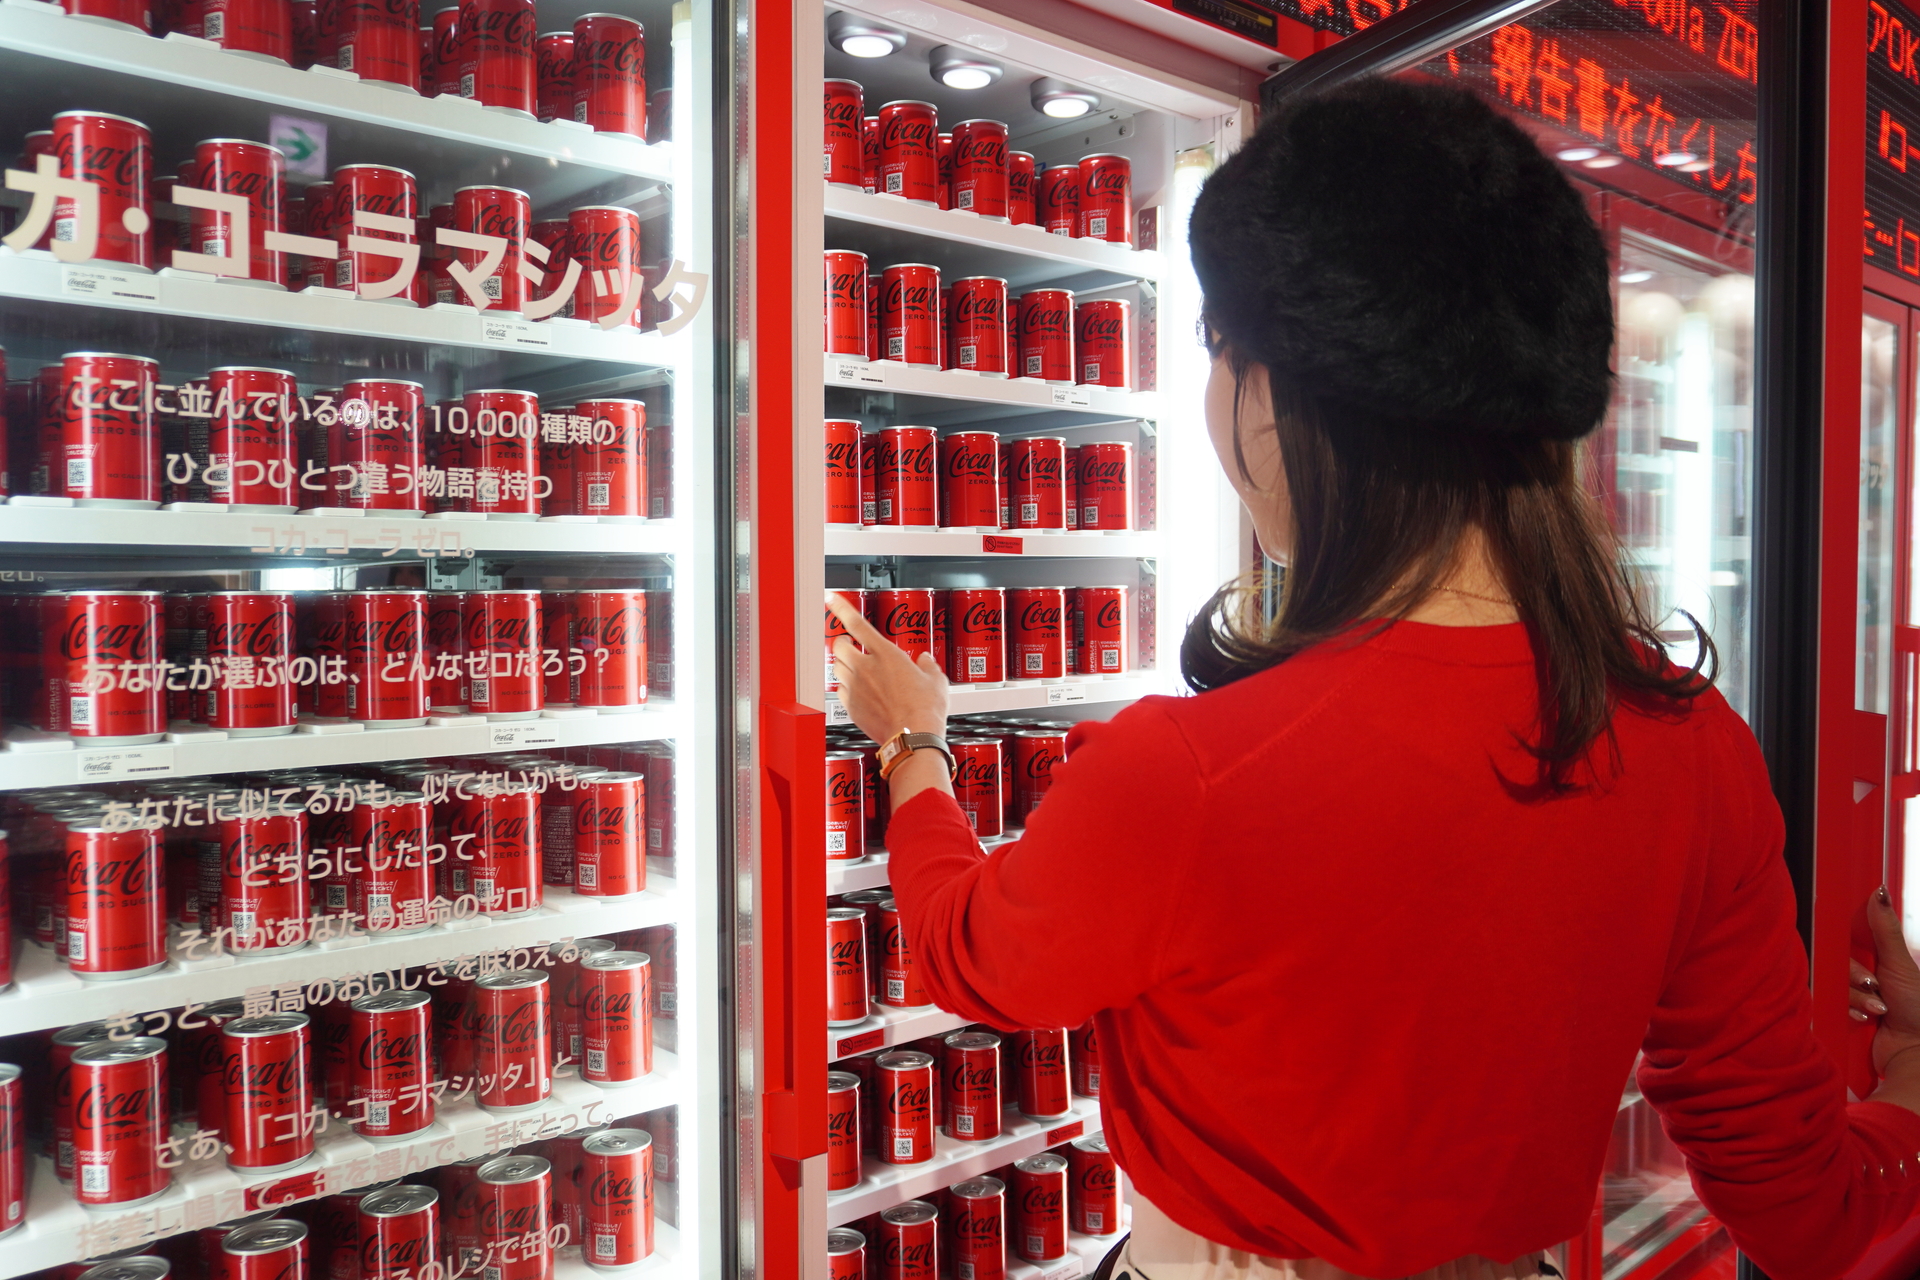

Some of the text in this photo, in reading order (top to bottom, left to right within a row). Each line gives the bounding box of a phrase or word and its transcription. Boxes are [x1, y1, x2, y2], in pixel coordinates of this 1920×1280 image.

[586, 73, 610, 81] ZERO
[901, 149, 924, 157] ZERO
[166, 453, 552, 501] ひとつひとつ違う物語を持つ
[251, 524, 401, 557] コカ・コーラ
[594, 838, 621, 846] ZERO
[492, 850, 520, 859] ZERO
[241, 833, 488, 887] どちらにしたって、
[82, 900, 116, 910] ZERO
[176, 887, 541, 960] それがあなたの運命のゼロ。
[105, 936, 592, 1042] きっと、最高のおいしさを味わえる。
[603, 1024, 629, 1033] ZERO
[501, 1043, 536, 1055] SUGAR
[387, 1070, 416, 1081] ZERO
[911, 1114, 930, 1122] ZERO
[106, 1129, 140, 1142] ZERO
[614, 1208, 638, 1217] ZERO
[901, 1270, 921, 1278] ZERO
